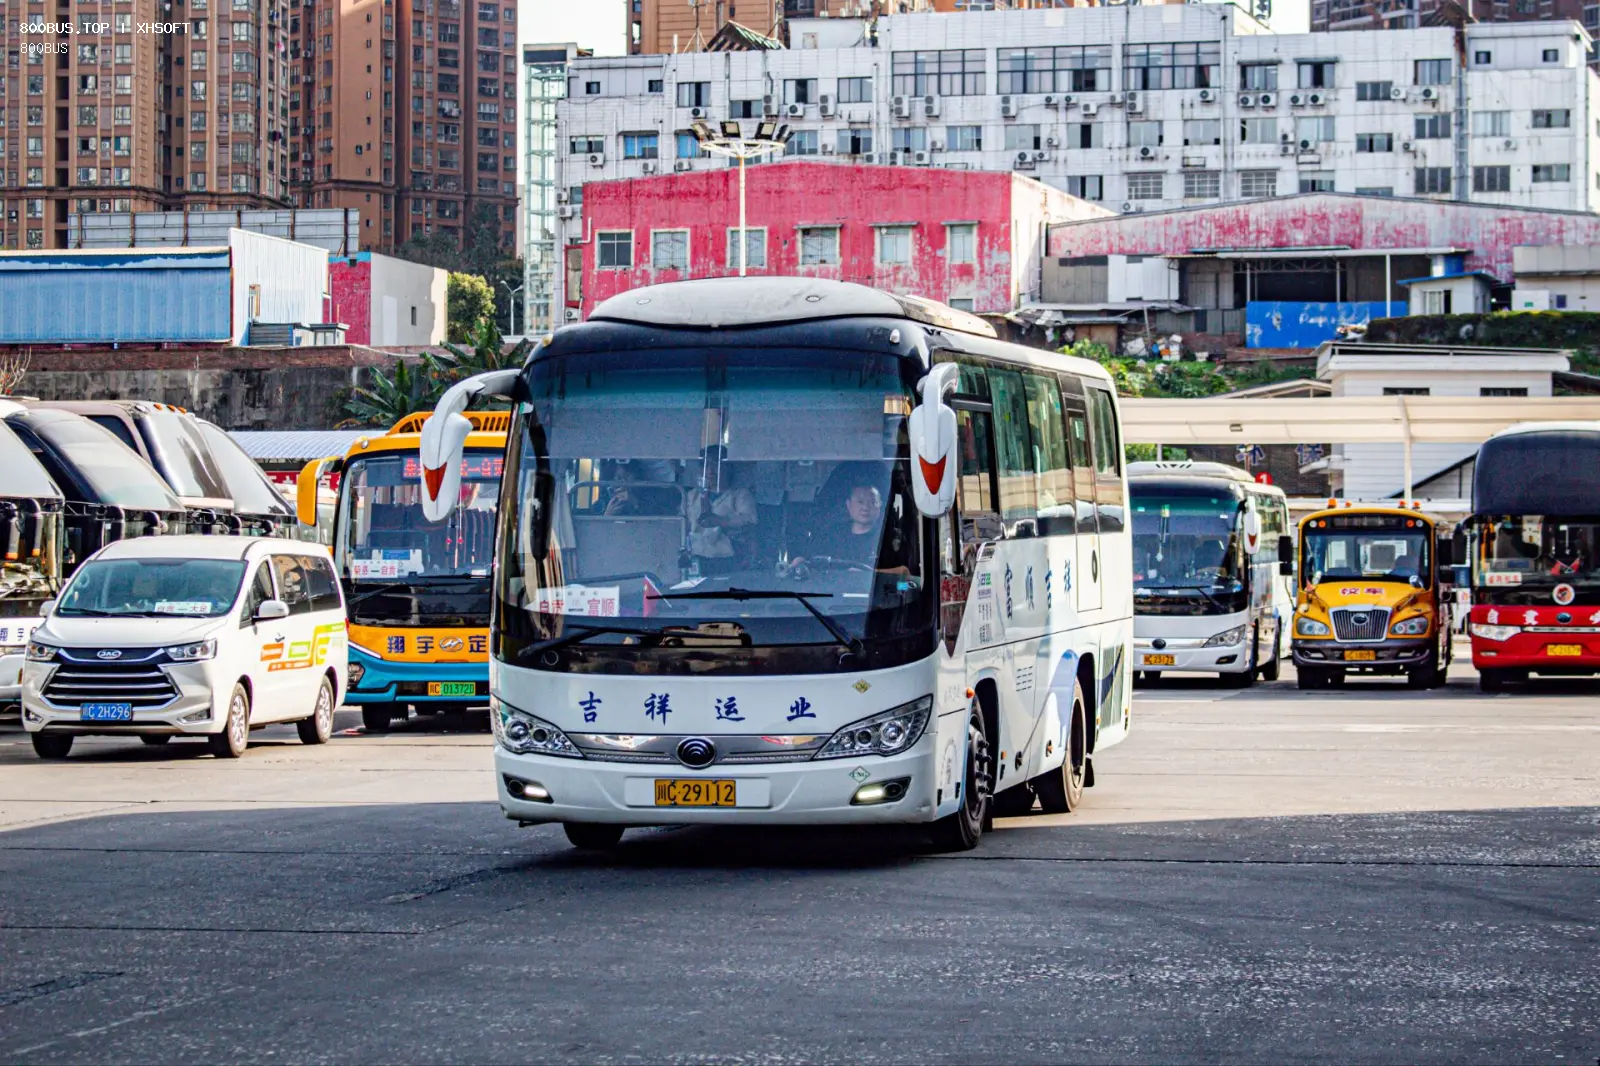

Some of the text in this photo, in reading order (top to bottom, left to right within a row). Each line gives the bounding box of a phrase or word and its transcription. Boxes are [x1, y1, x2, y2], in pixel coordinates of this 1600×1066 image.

[468, 634, 487, 653] 定
[578, 691, 817, 726] 吉祥运业
